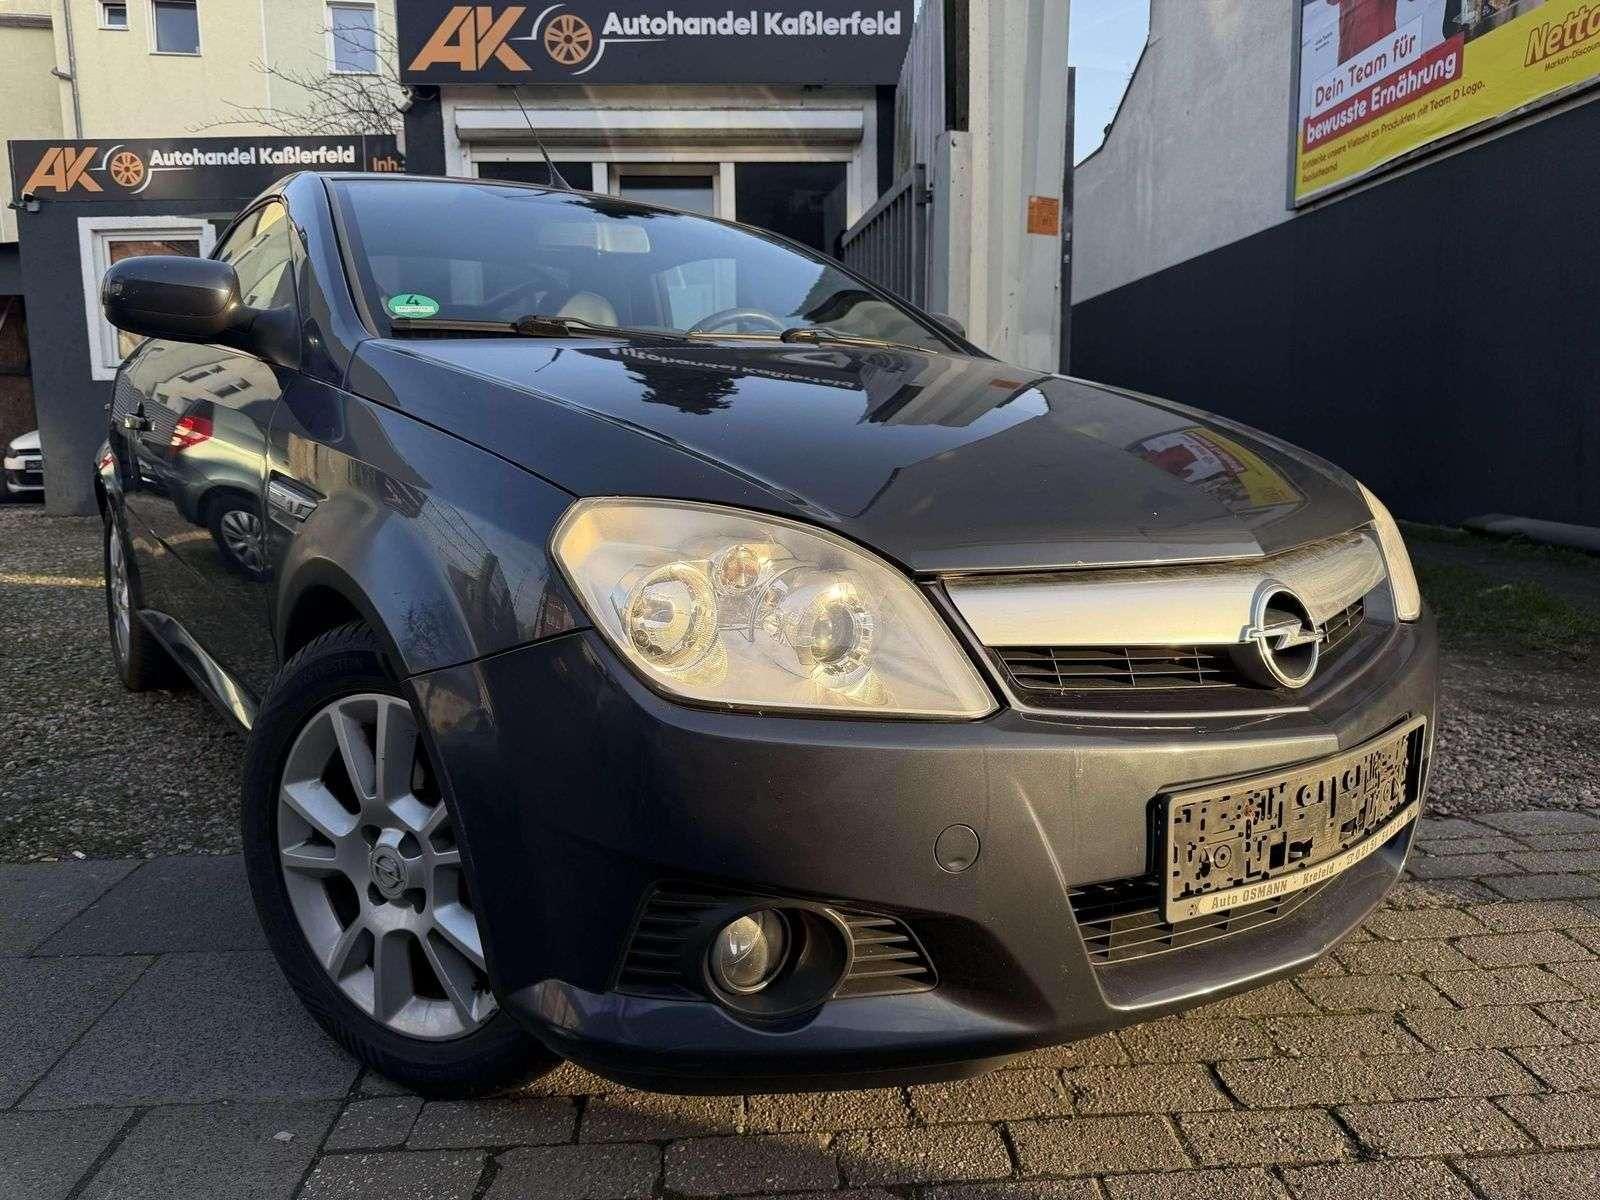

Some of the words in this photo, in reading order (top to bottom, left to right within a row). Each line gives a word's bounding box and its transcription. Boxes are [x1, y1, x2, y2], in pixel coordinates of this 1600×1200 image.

[408, 6, 533, 71] AK
[602, 10, 758, 36] Autohandel
[763, 10, 901, 36] Kaßlerfeld
[1524, 4, 1600, 68] Netto
[1315, 77, 1344, 107] Dein
[1348, 52, 1387, 87] Team
[1393, 33, 1416, 62] für
[1306, 99, 1367, 145] bewusste
[1371, 52, 1457, 112] Ernährung
[1430, 94, 1451, 112] Team
[1453, 88, 1460, 101] D
[1461, 80, 1486, 98] Logo.
[21, 147, 104, 193] AK
[150, 147, 256, 167] Autohandel
[258, 145, 355, 166] Kaßlerfeld
[1210, 895, 1238, 910] Auto
[1242, 879, 1288, 901] OSMANN
[1303, 862, 1335, 885] Krefeld
